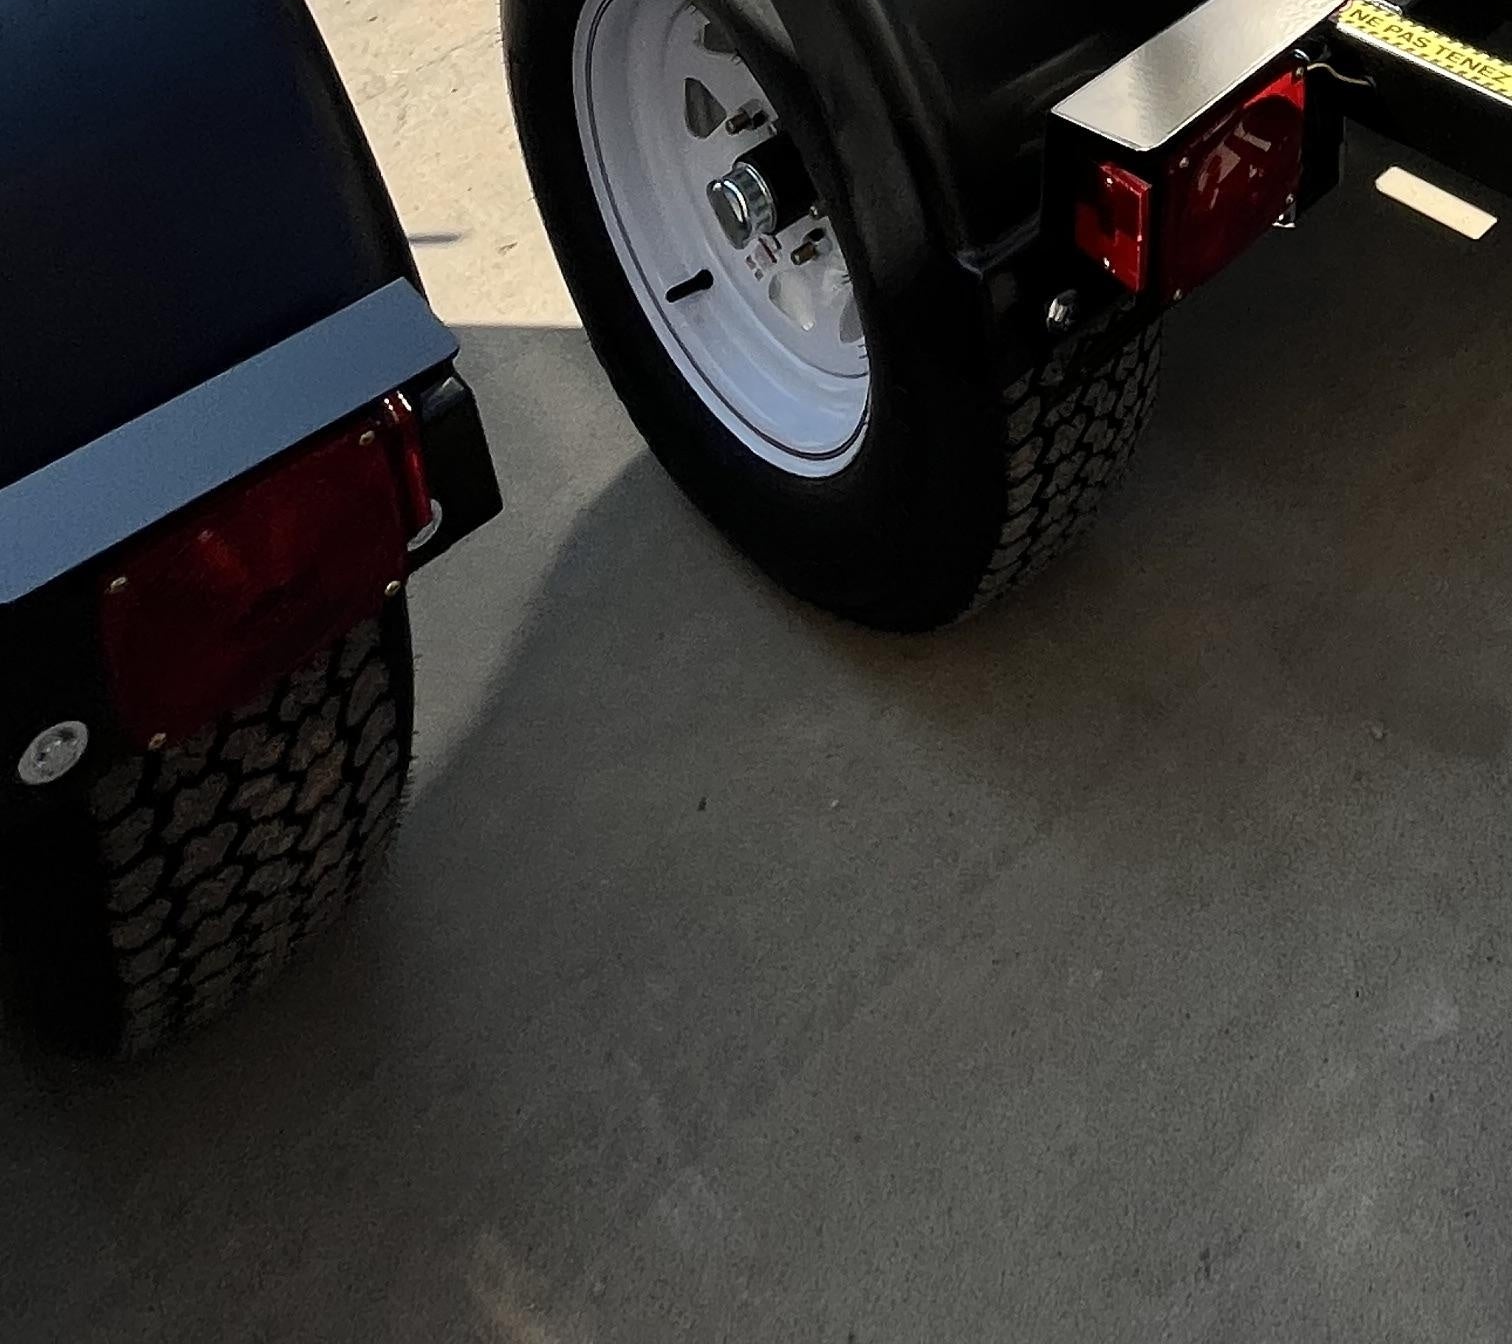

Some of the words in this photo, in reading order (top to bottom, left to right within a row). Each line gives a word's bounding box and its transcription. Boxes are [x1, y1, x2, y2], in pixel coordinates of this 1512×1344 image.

[1350, 8, 1378, 28] NE
[1386, 23, 1432, 50] PAS
[1435, 46, 1512, 84] TENEZ
